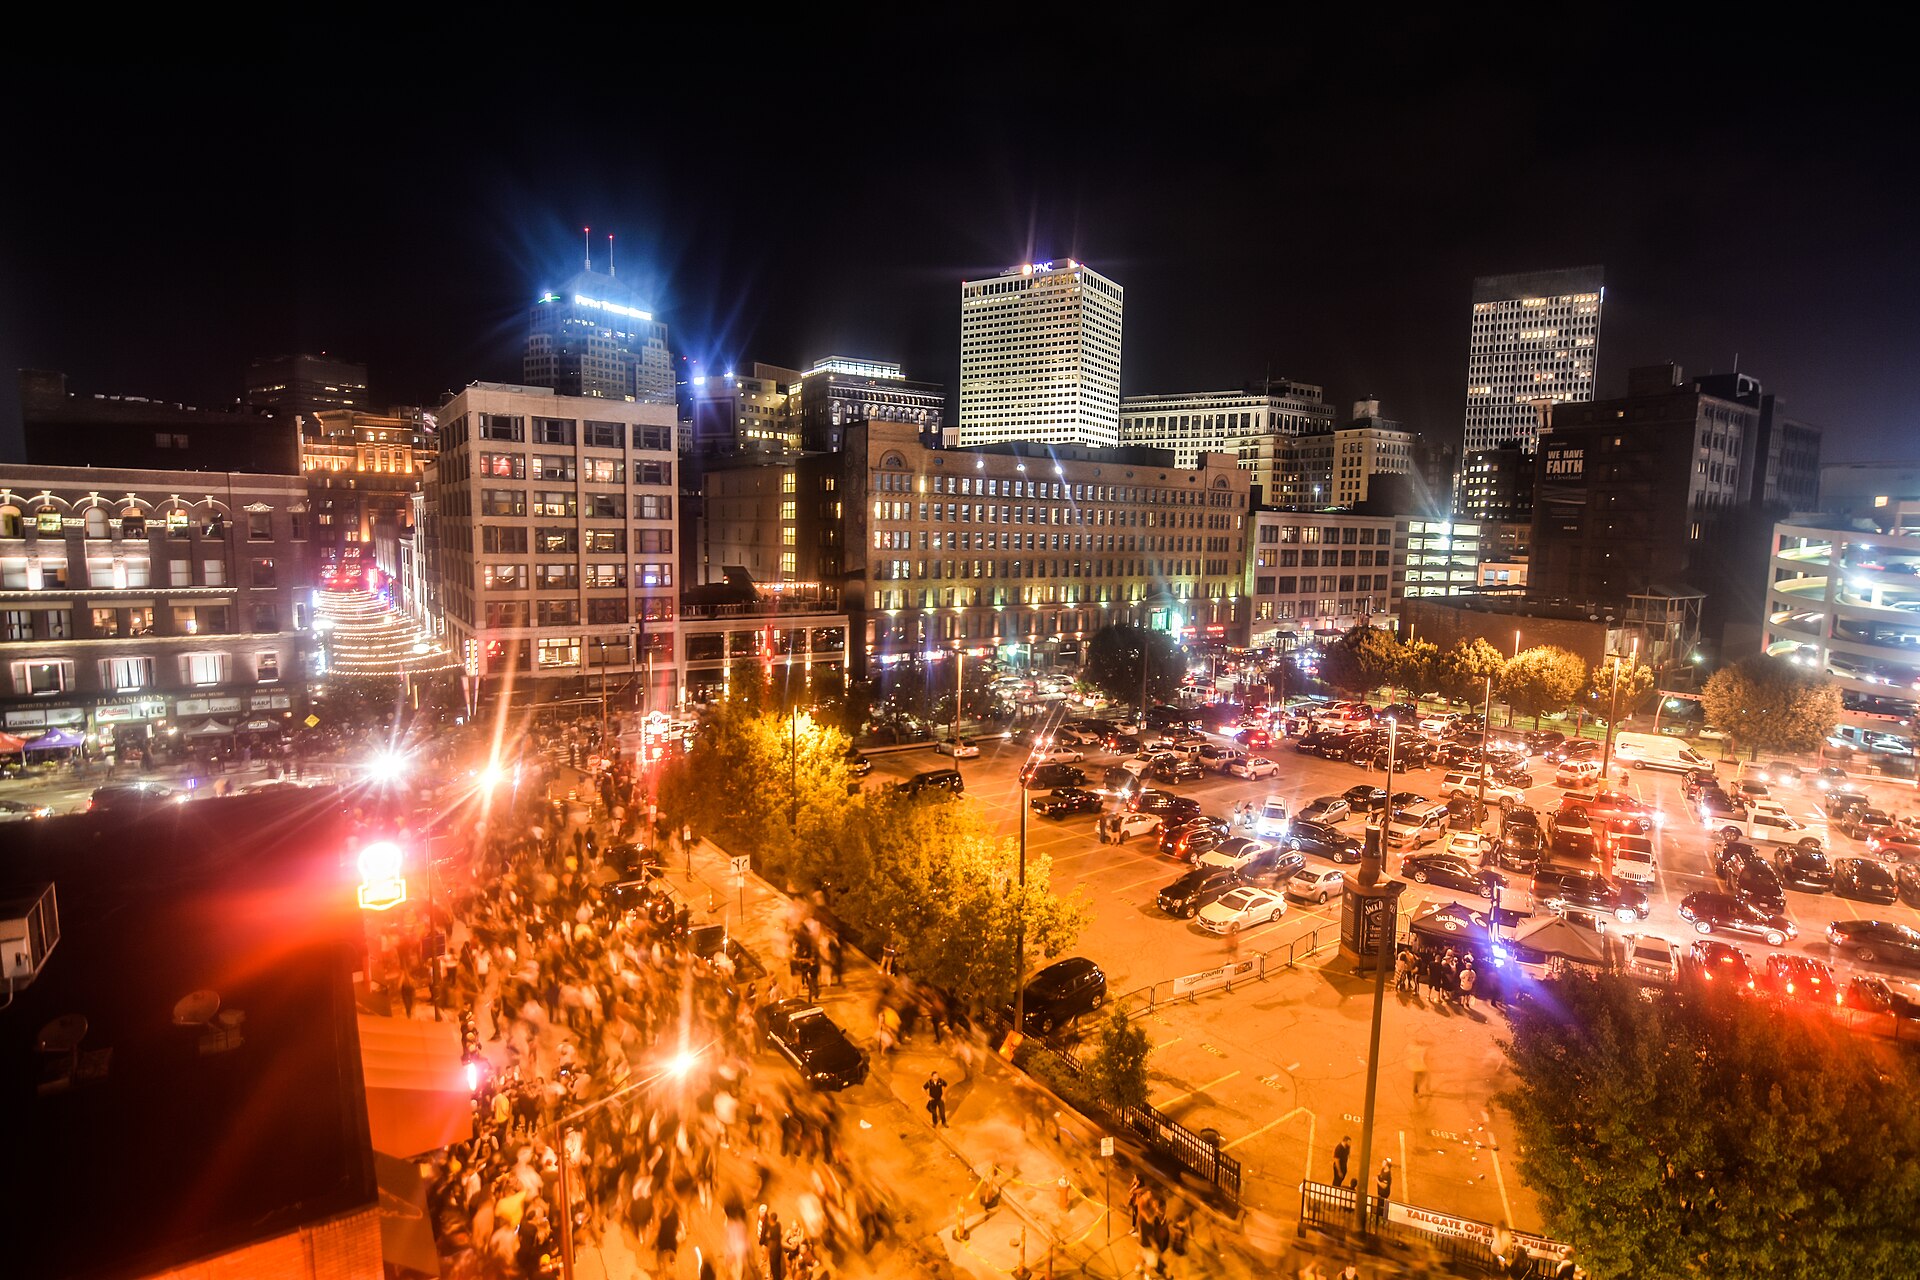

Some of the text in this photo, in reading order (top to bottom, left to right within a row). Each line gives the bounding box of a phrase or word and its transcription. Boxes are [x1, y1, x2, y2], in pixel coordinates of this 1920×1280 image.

[1033, 262, 1053, 274] PNC
[1548, 449, 1584, 459] WE HAVE
[1546, 459, 1583, 473] FAITH
[1365, 902, 1379, 915] JACK
[1435, 914, 1449, 922] JACK
[1343, 1112, 1364, 1124] 00
[1406, 1209, 1461, 1230] TAILGATE
[1522, 1238, 1566, 1255] PUBLIC
[1436, 1226, 1465, 1238] WATCH
[1467, 1233, 1481, 1242] THE
